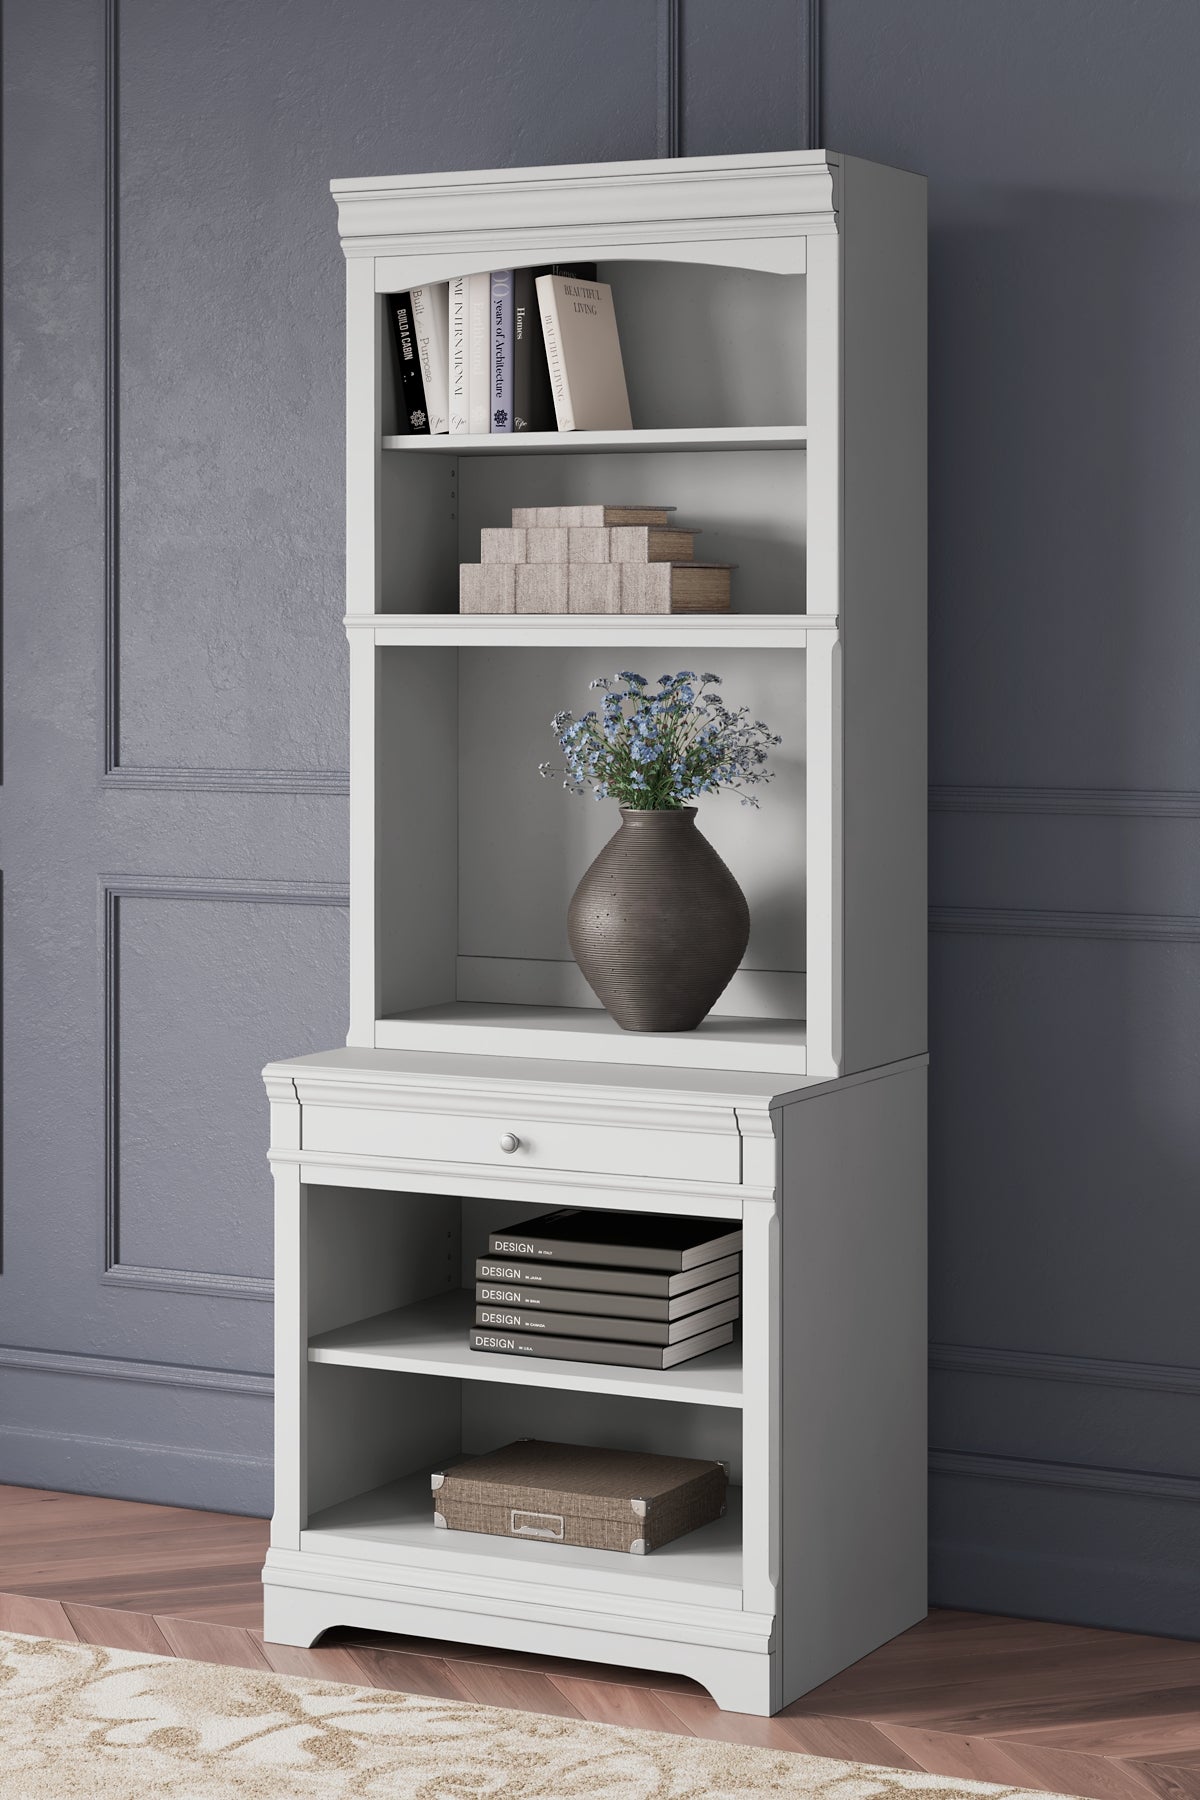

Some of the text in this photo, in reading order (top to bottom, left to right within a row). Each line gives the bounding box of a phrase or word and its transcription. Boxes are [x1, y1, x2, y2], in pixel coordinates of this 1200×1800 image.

[564, 284, 602, 301] BEAUTIFUL
[494, 300, 503, 325] years
[573, 302, 597, 315] LIVING
[397, 308, 409, 331] BUILD
[517, 307, 525, 340] Homes
[413, 290, 424, 315] Built
[420, 337, 432, 383] Purpose
[496, 328, 505, 339] of
[402, 337, 414, 360] CABIN
[454, 302, 463, 395] INTERNATIONAL
[496, 340, 505, 398] Architecture
[495, 1241, 534, 1254] DESIGN
[481, 1266, 521, 1279] DESIGN
[481, 1289, 521, 1302] DESIGN
[481, 1312, 521, 1326] DESIGN
[475, 1336, 515, 1349] DESIGN
